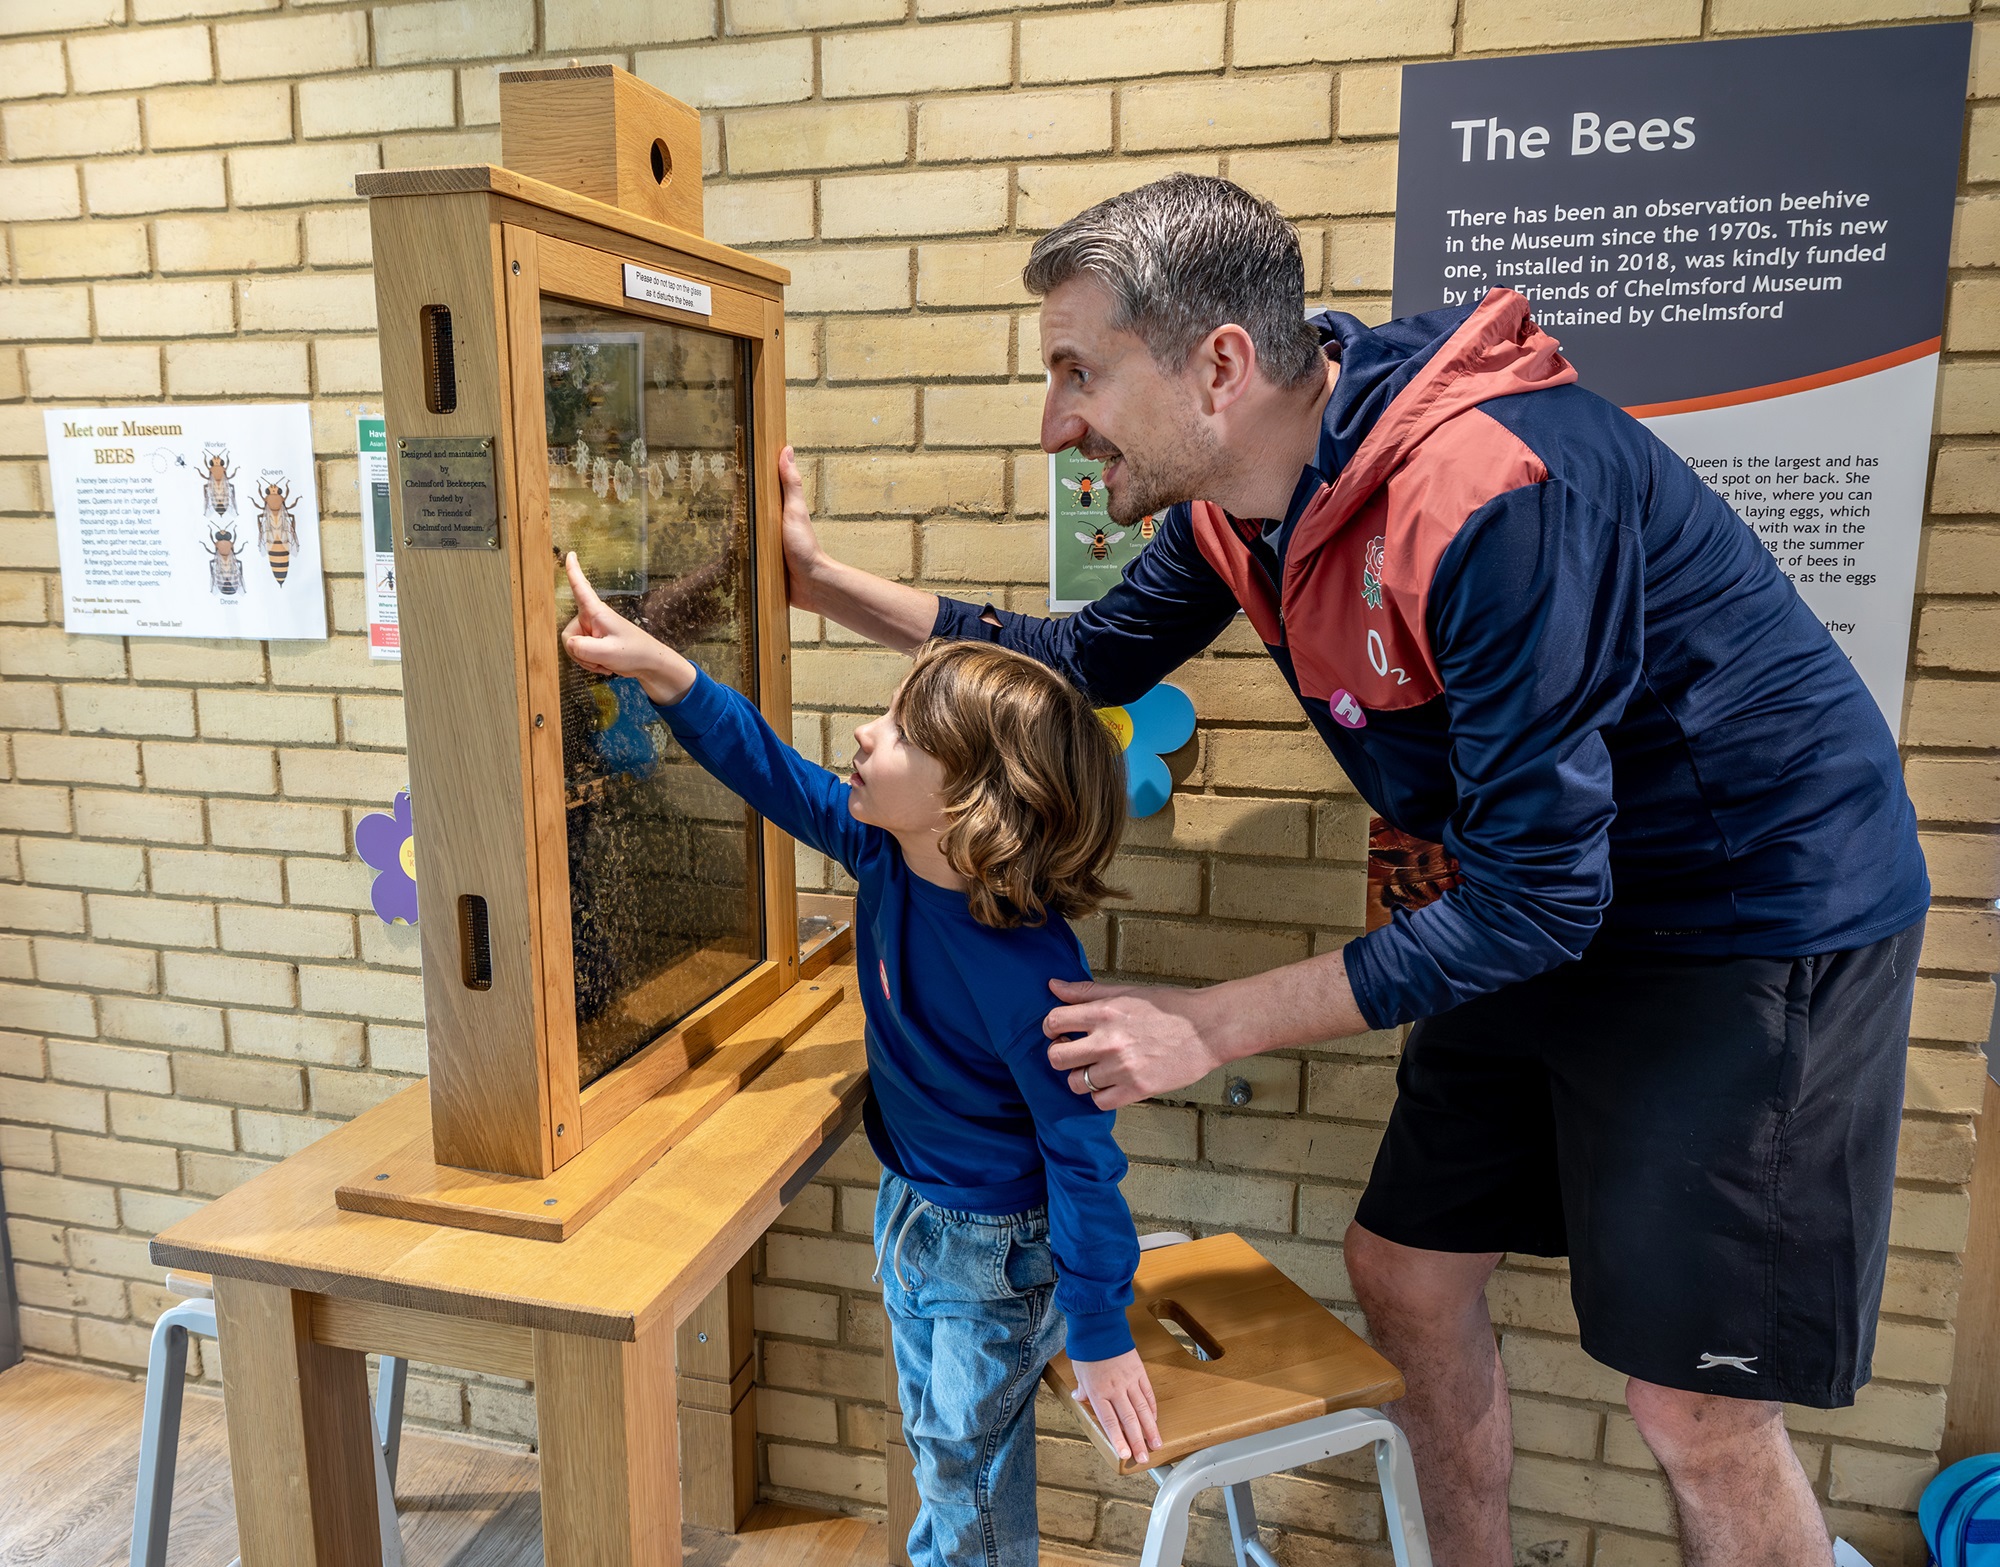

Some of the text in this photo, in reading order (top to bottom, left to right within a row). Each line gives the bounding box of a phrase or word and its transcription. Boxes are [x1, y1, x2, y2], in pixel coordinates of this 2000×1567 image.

[1450, 111, 1696, 163] The Bees
[1446, 190, 1870, 227] There has been an observation beehive
[1445, 218, 1889, 253] in the Museum since the 1970s. This new
[1443, 242, 1887, 281] one, installed in 2018, was kindly funded
[636, 271, 652, 284] Please
[660, 280, 668, 288] not
[691, 287, 702, 296] glass
[1443, 286, 1467, 307] by
[1596, 280, 1619, 299] of
[1624, 275, 1746, 298] Chelmsford
[1751, 274, 1842, 293] Museum
[657, 292, 674, 302] disturbs
[683, 297, 694, 307] bees.
[1628, 305, 1655, 328] by
[1660, 300, 1784, 323] Chelmsford
[62, 420, 183, 438] Meet our Museum
[93, 448, 135, 465] BEES
[401, 450, 487, 460] Designed and maintained
[440, 465, 450, 475] by
[1685, 455, 1878, 471] Queen is the largest and has
[261, 469, 283, 477] Queen
[1722, 474, 1750, 487] spot
[1755, 475, 1771, 484] on
[1776, 472, 1799, 484] her
[1803, 472, 1839, 484] back.
[1846, 472, 1870, 484] She
[405, 480, 487, 490] Chelmsford Beekeepers,
[429, 494, 464, 504] funded by
[1734, 489, 1766, 502] hive,
[1772, 489, 1814, 500] where
[1819, 492, 1843, 503] you
[1848, 492, 1872, 500] can
[437, 509, 463, 517] Friends
[465, 509, 472, 517] of
[1744, 505, 1786, 520] laying
[1790, 508, 1824, 520] eggs,
[1830, 506, 1870, 517] which
[413, 524, 484, 532] Chelmsford Museum.
[1759, 522, 1788, 533] with
[1793, 525, 1820, 533] wax
[1825, 522, 1837, 533] in
[1842, 522, 1865, 534] the
[1783, 538, 1805, 550] the
[1810, 541, 1865, 550] summer
[1788, 554, 1803, 566] of
[1807, 555, 1838, 566] bees
[1843, 555, 1855, 566] in
[1800, 574, 1814, 582] as
[1819, 571, 1842, 582] the
[1846, 574, 1876, 586] eggs
[1825, 620, 1856, 635] they
